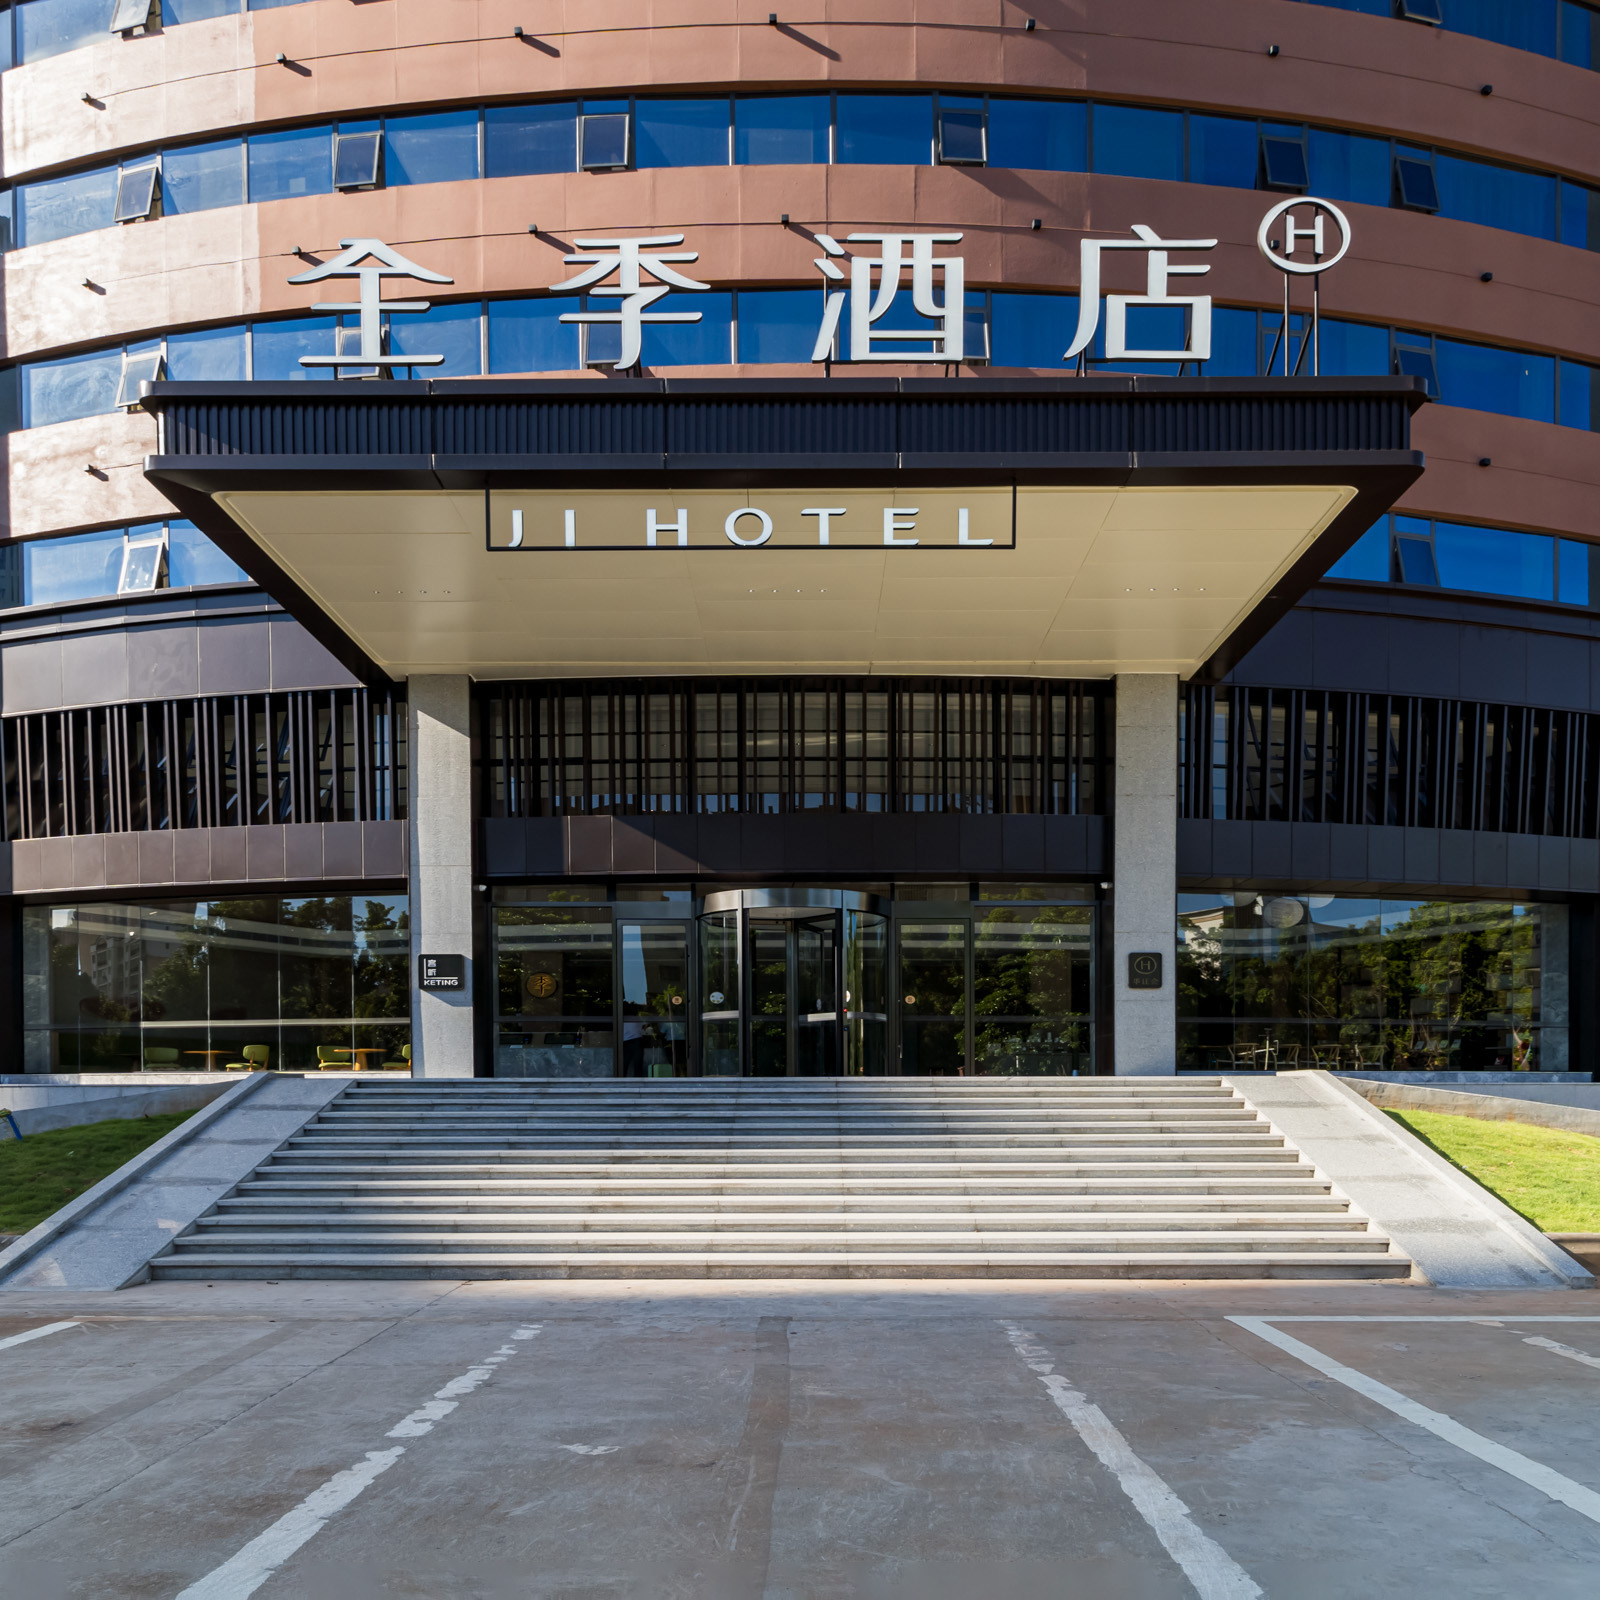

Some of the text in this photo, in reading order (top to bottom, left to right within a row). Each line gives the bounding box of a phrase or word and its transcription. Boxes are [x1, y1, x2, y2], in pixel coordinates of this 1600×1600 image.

[288, 224, 1218, 370] 全季酒店
[509, 507, 994, 548] JI HOTEL
